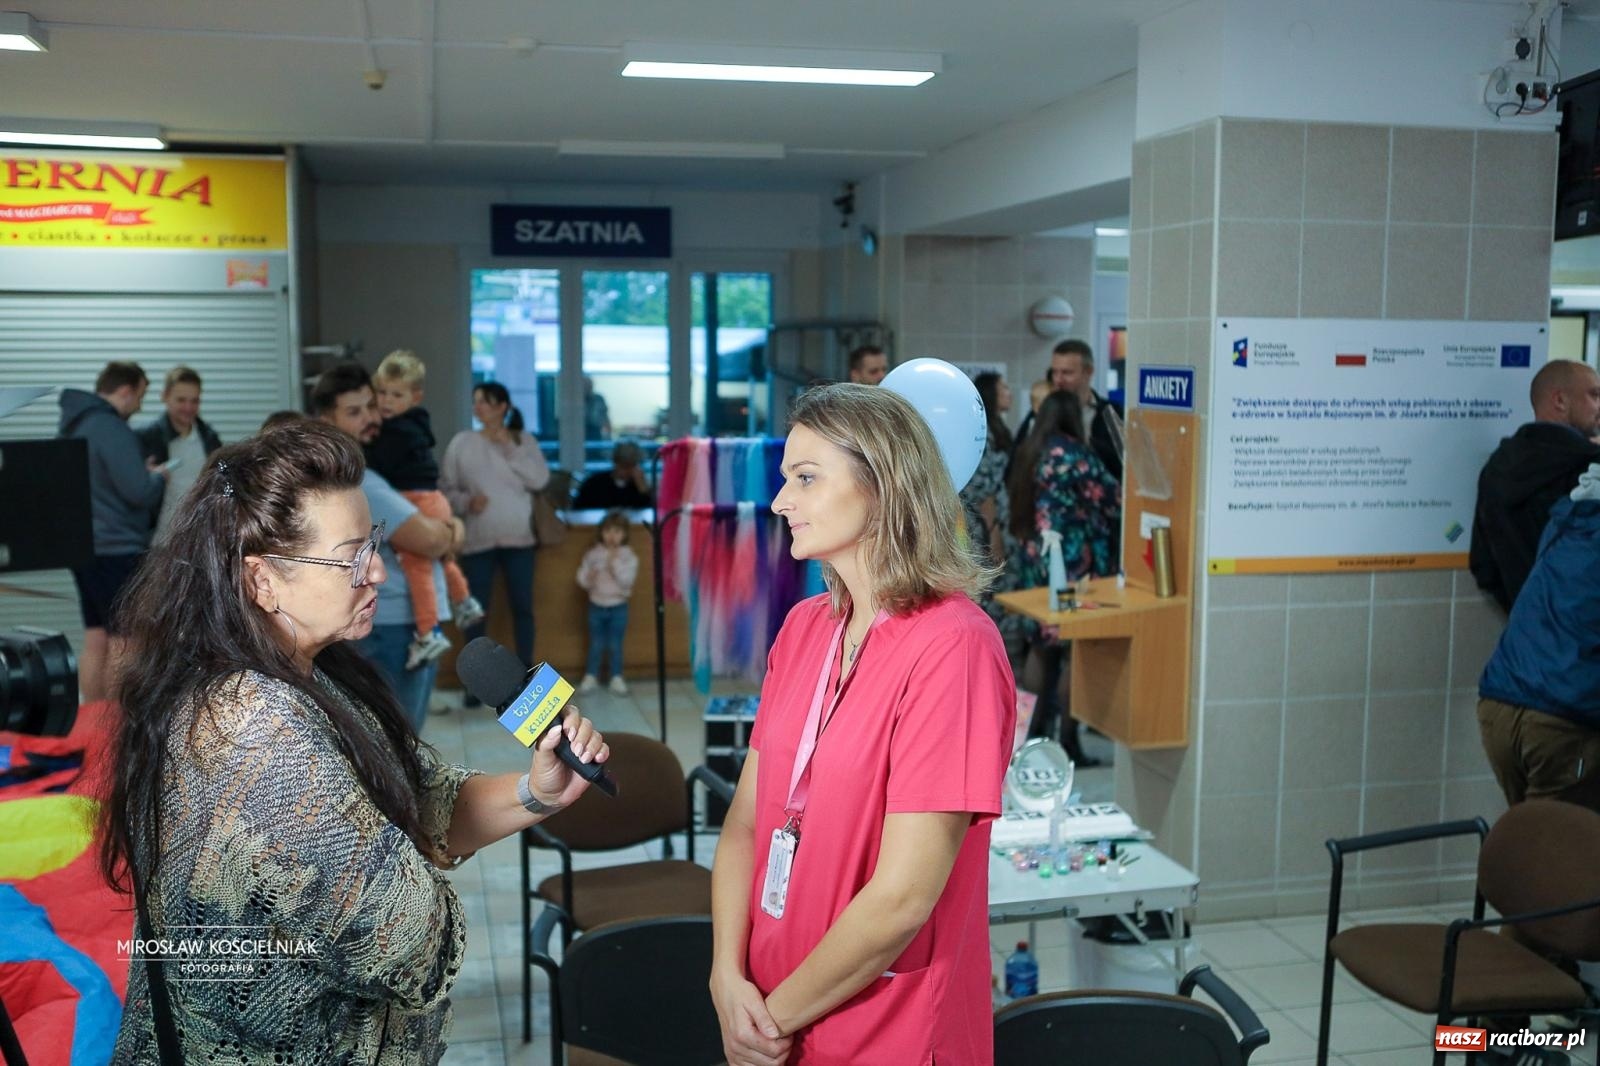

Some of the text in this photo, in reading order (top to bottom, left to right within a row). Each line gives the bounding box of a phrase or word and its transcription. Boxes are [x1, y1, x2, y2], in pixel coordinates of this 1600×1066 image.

[514, 219, 645, 244] SZATNIA
[1254, 341, 1287, 350] Fundusze
[1443, 344, 1458, 353] Unia
[1254, 351, 1296, 360] Europejskie
[1373, 356, 1395, 364] Polska
[1144, 374, 1189, 402] ANKIETY
[1292, 398, 1328, 408] dostępu
[1330, 398, 1341, 408] do
[1343, 398, 1386, 408] cyfrowych
[1413, 398, 1461, 408] publicznych
[1469, 398, 1502, 408] obszaru
[1232, 408, 1275, 419] e-zdrowia
[1286, 408, 1322, 419] Szpitalu
[1324, 408, 1373, 419] Rejonowym
[1429, 408, 1458, 419] Rostka
[1230, 434, 1280, 445] Cel projektu:
[1228, 501, 1274, 511] Beneficjent:
[513, 684, 544, 717] tylko
